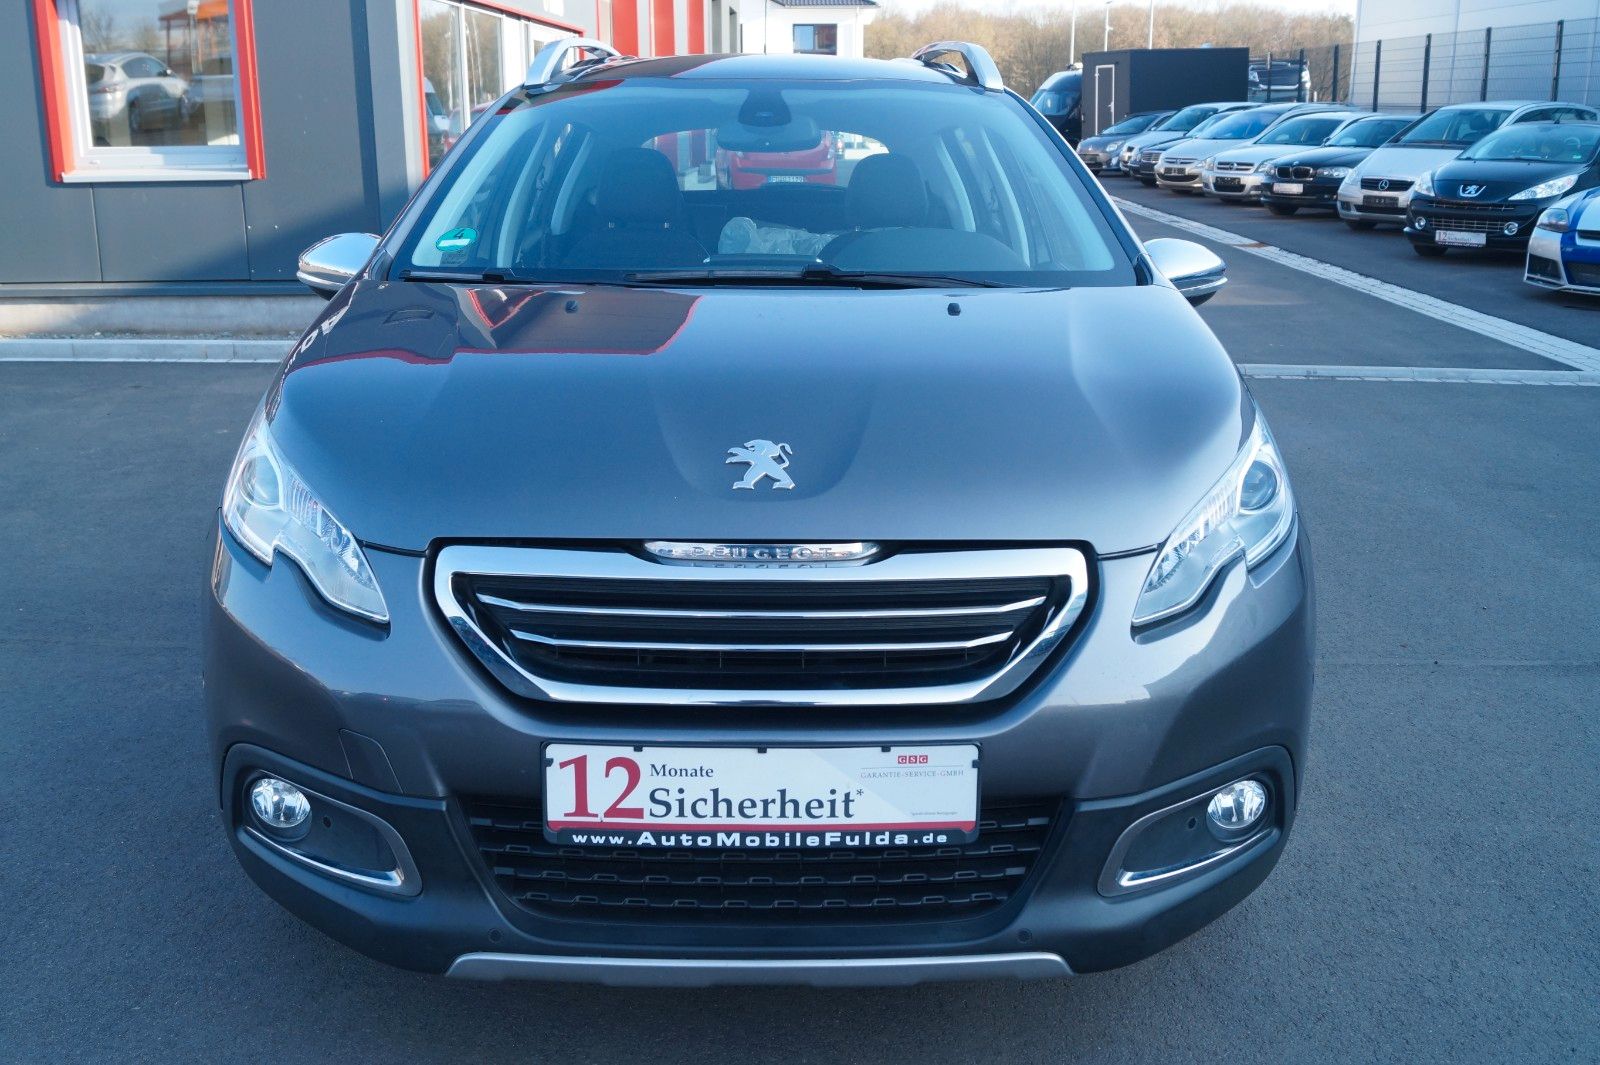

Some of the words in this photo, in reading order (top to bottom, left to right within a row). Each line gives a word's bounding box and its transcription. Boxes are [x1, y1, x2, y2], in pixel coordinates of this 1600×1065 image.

[691, 546, 832, 559] PEUGEOT
[898, 755, 928, 764] GSG
[650, 763, 714, 778] Monate
[559, 755, 644, 819] 12
[572, 831, 948, 847] www.AutoMobileFulda.de
